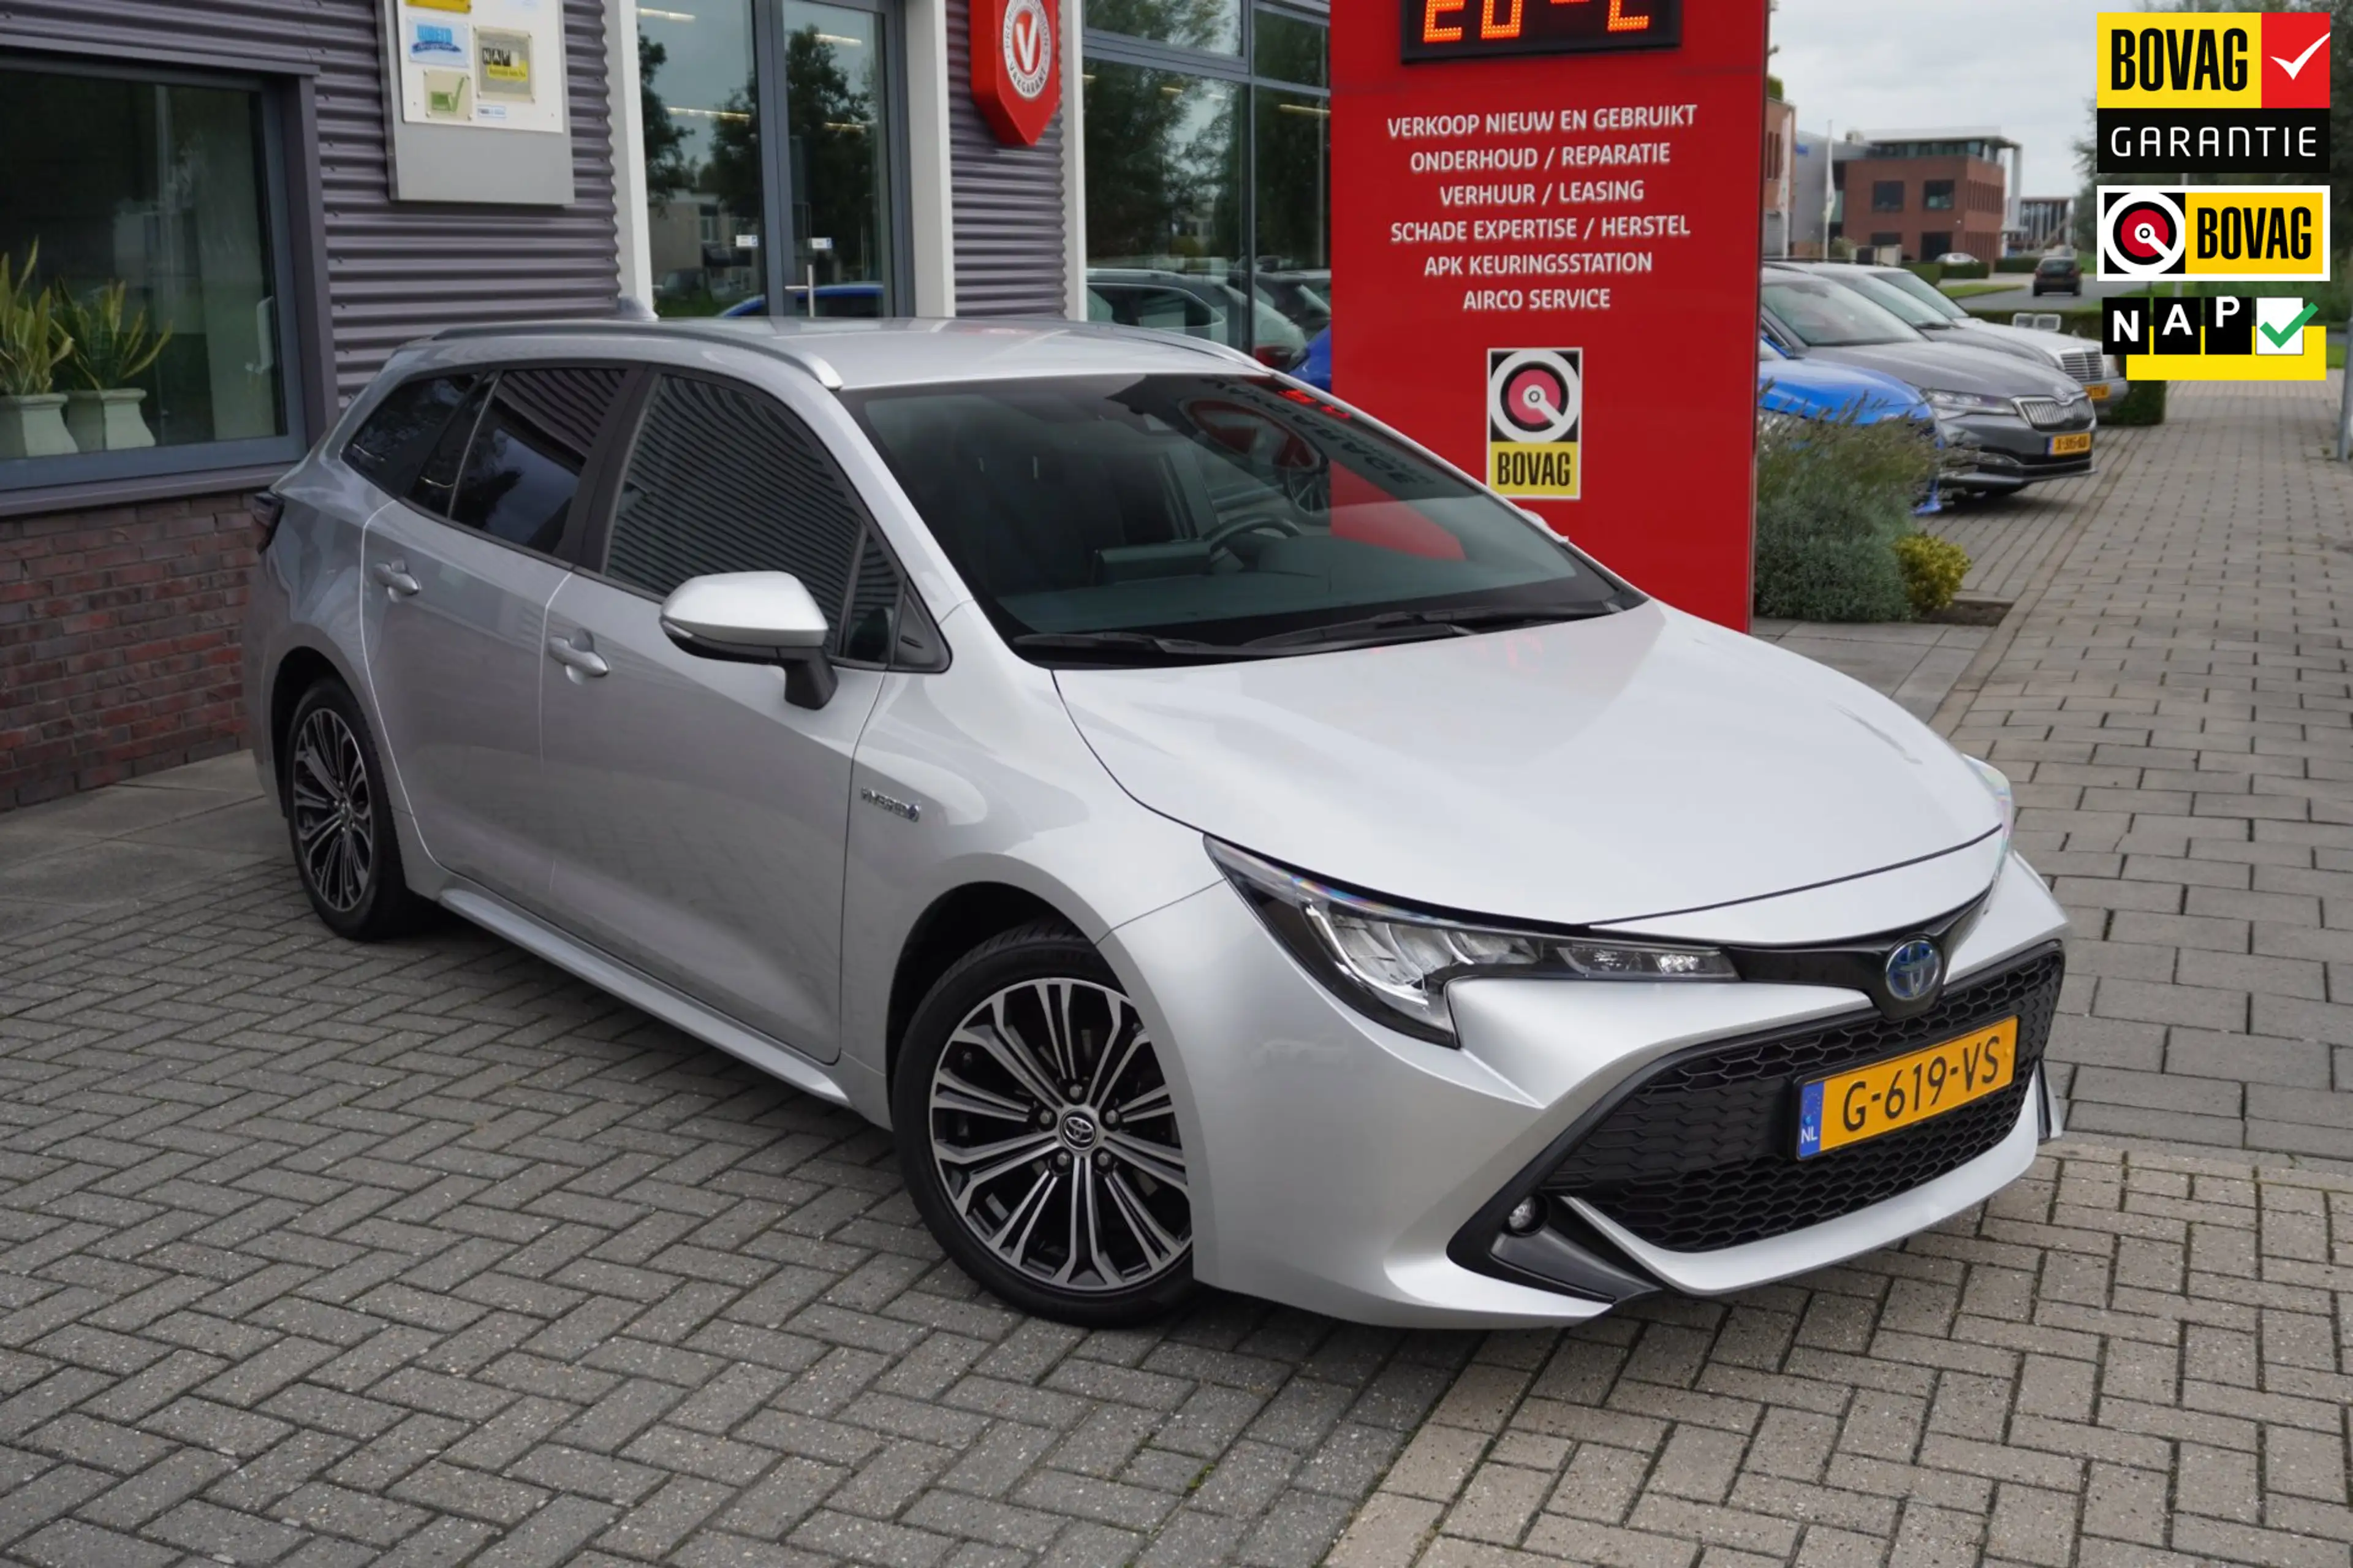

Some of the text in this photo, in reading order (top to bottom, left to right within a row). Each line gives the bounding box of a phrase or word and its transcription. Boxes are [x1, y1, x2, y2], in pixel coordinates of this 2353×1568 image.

[1388, 105, 1697, 138] VERKOOP NIEUW EN GEBRUIKT
[1411, 143, 1670, 172] ONDERHOUD / REPARATIE
[1440, 180, 1644, 206] VERHUUR / LEASING
[1392, 215, 1691, 243] SCHADE EXPERTISE / HERSTEL
[1425, 252, 1652, 276] APK KEURINGSSTATION
[1463, 289, 1611, 310] AIRCO SERVICE
[1498, 452, 1571, 487] BOVAG
[1843, 1036, 1999, 1132] G-619-VS
[1801, 1127, 1818, 1144] NL
